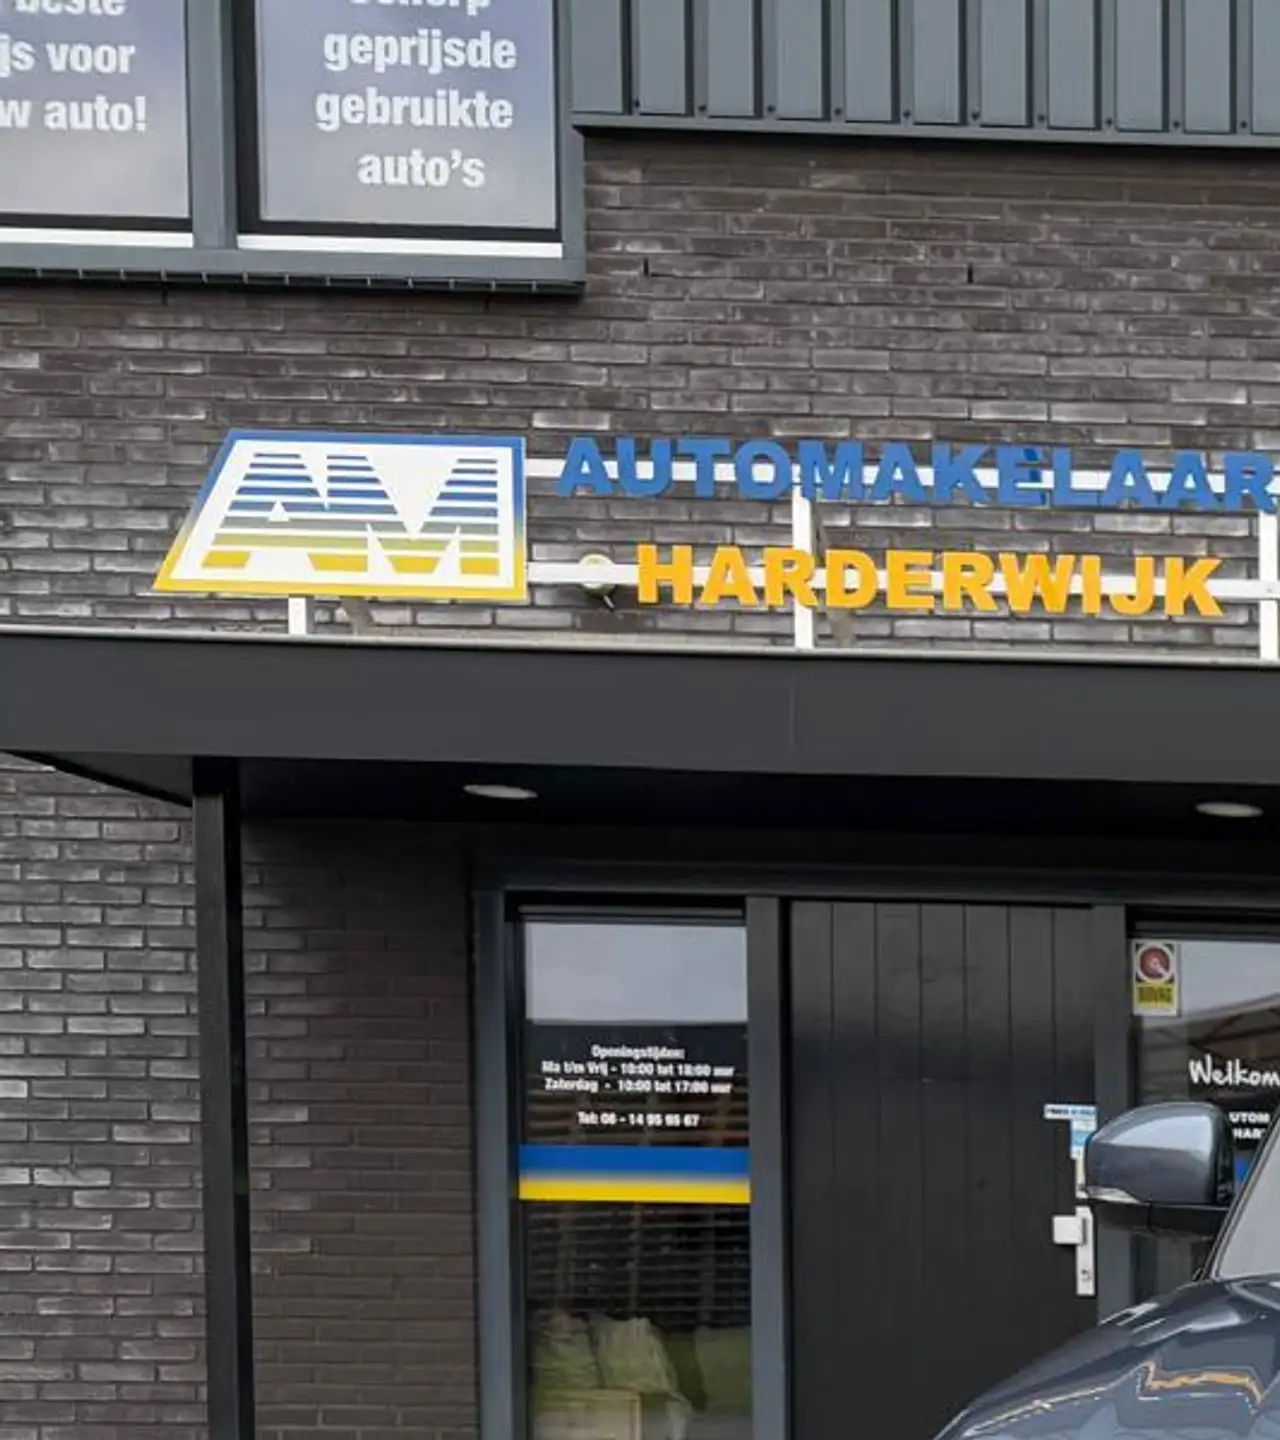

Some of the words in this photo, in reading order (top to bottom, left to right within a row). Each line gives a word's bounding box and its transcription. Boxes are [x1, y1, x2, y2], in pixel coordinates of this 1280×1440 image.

[45, 42, 136, 74] voor
[323, 28, 518, 75] geprijsde
[44, 94, 146, 132] auto!
[315, 86, 514, 132] gebruikte
[357, 148, 486, 188] auto's
[557, 436, 1277, 514] AUTOMAKELAAR
[636, 544, 1223, 617] HARDERWIJK
[629, 1113, 644, 1126] 14
